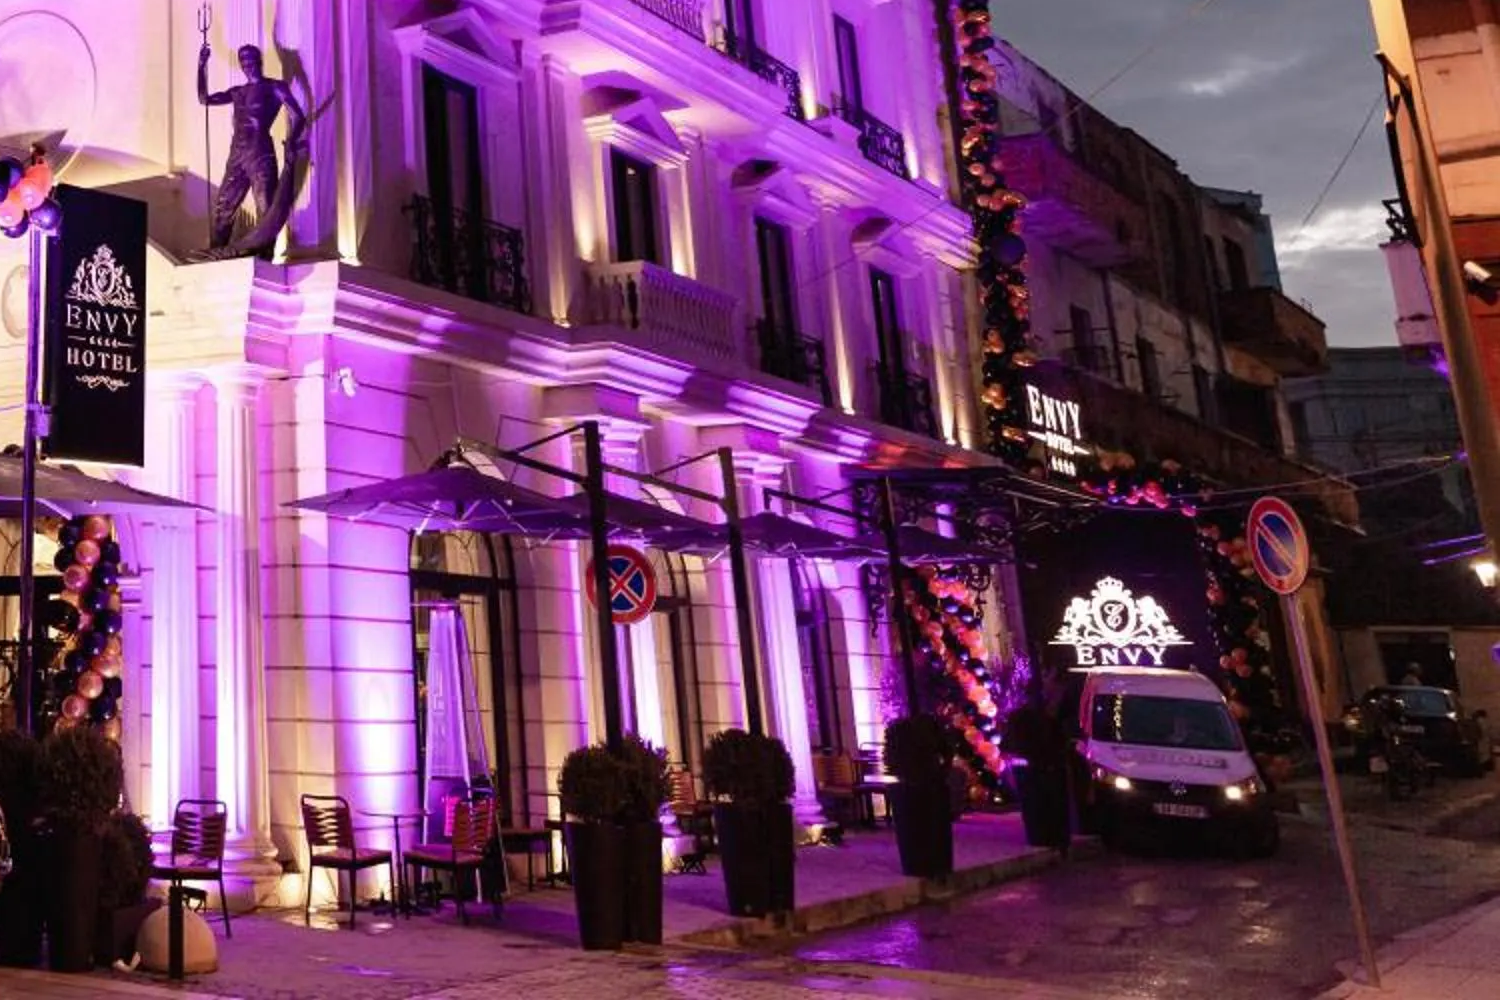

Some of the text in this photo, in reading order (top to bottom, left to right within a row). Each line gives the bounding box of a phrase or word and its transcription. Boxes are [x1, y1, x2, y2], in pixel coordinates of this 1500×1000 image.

[65, 303, 138, 337] ENVY
[66, 347, 138, 373] HOTEL
[1026, 383, 1081, 440] ENVY
[1076, 646, 1167, 665] ENVY
